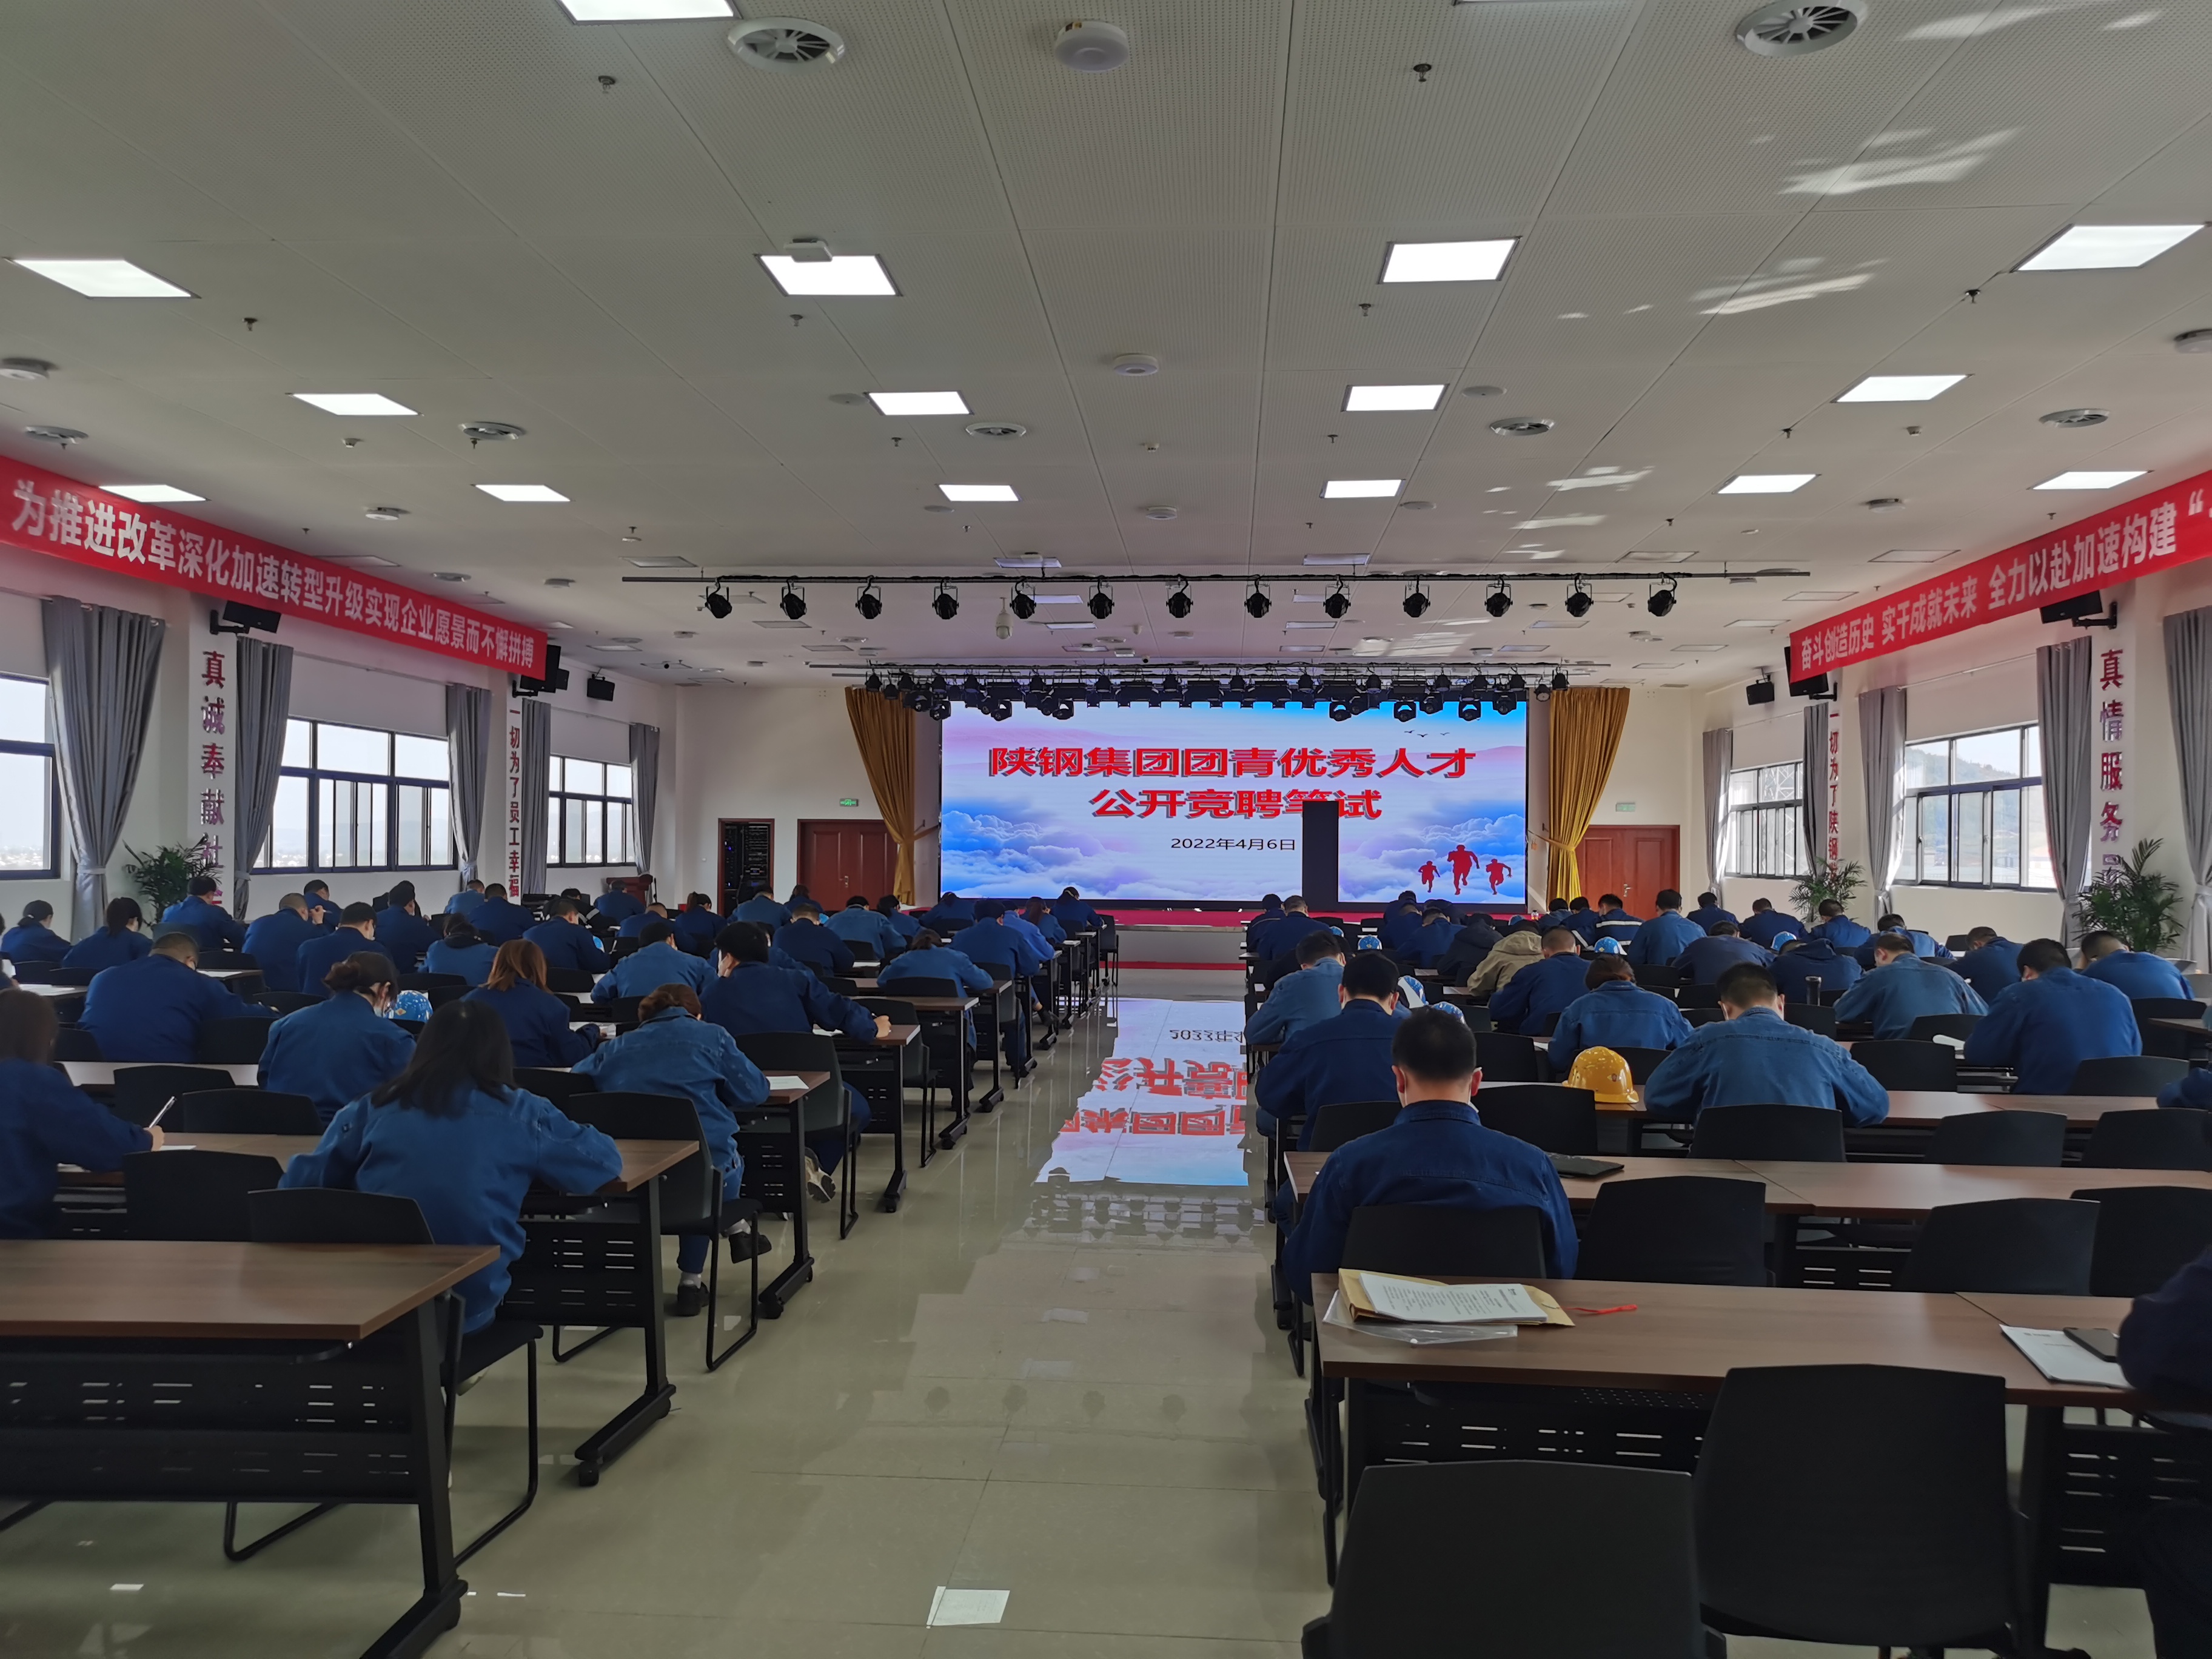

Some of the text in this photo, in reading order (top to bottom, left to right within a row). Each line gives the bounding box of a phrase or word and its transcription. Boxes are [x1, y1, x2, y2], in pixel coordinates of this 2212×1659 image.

[12, 480, 534, 668] 为推进改革深化加速转型升级实现企业愿景而不懈拼搏
[1801, 613, 1874, 671] 奋斗创造历史
[1882, 575, 1978, 645] 实干成就未来
[509, 709, 520, 897] 一切为了员工幸福
[990, 746, 1476, 779] 陕钢集团团青优秀人才
[1171, 838, 1295, 850] 2022年4月6日
